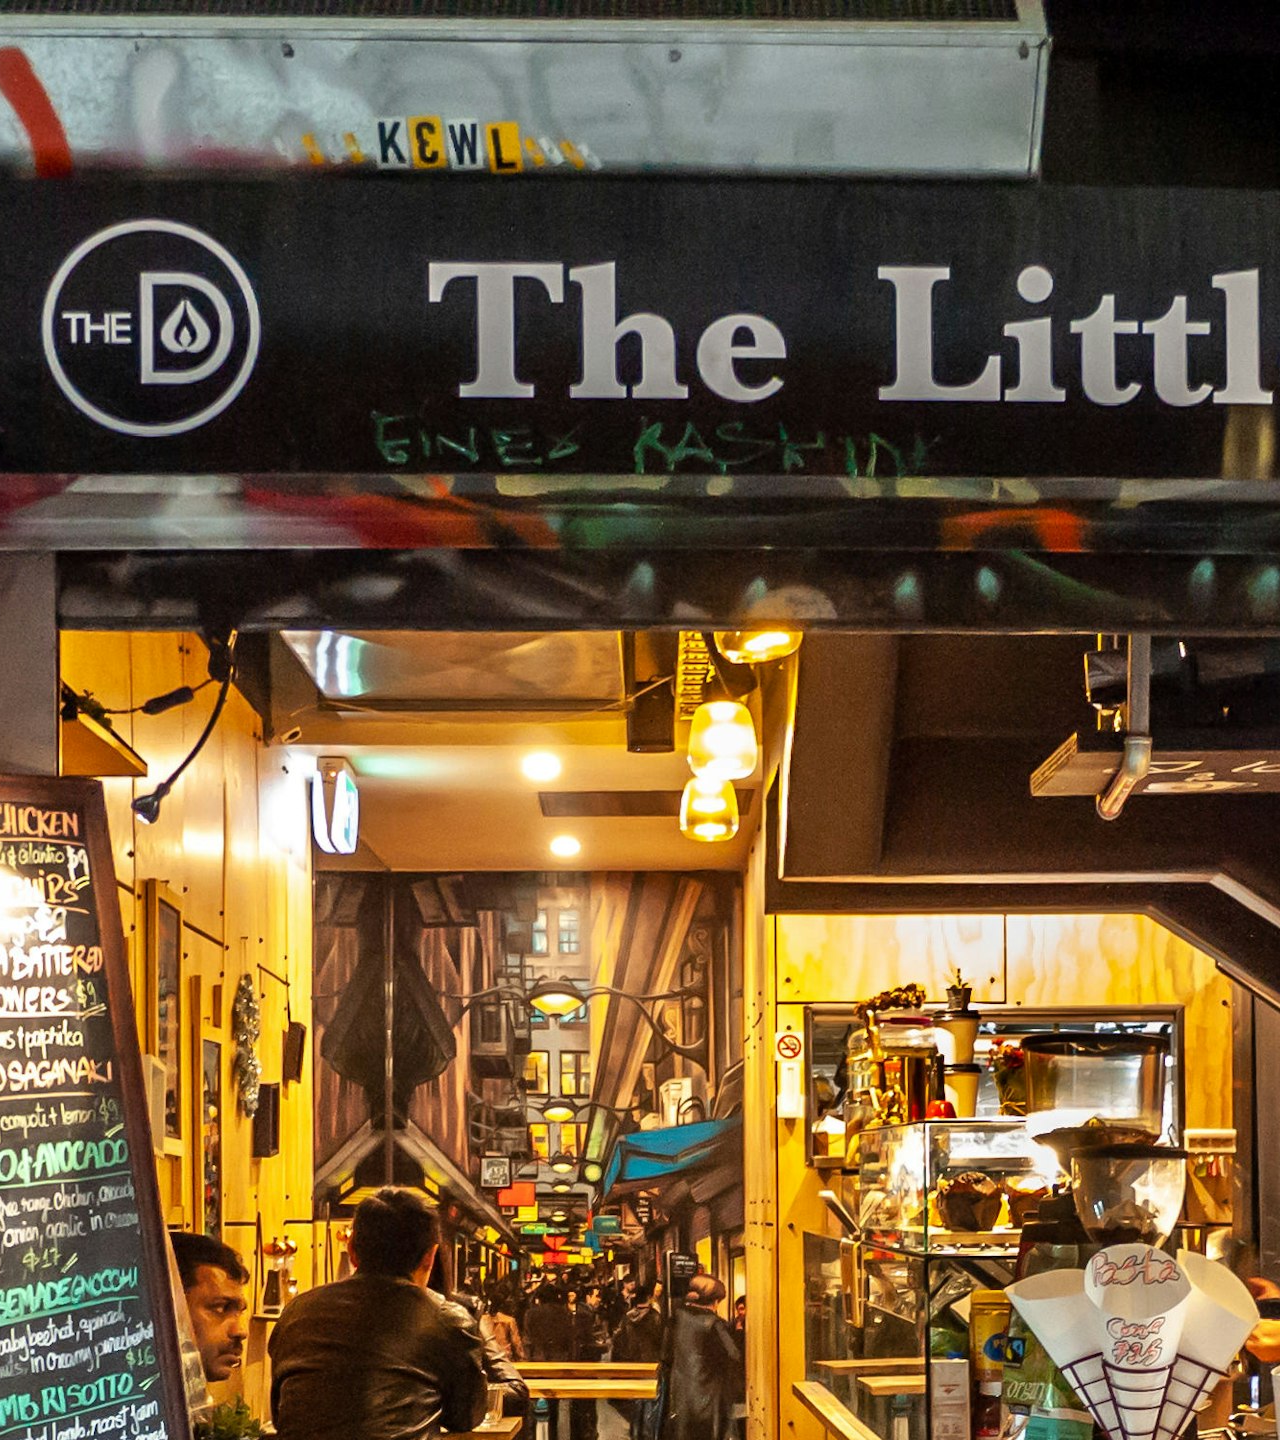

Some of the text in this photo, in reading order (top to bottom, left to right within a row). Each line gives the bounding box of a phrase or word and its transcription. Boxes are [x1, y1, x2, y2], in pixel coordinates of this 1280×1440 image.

[62, 272, 234, 385] THE D
[428, 261, 787, 402] The
[8, 1056, 112, 1092] SAGANAKI
[32, 1140, 128, 1180] AVOCADO
[1091, 1250, 1181, 1288] Pasta
[42, 1373, 133, 1416] RISOTTO
